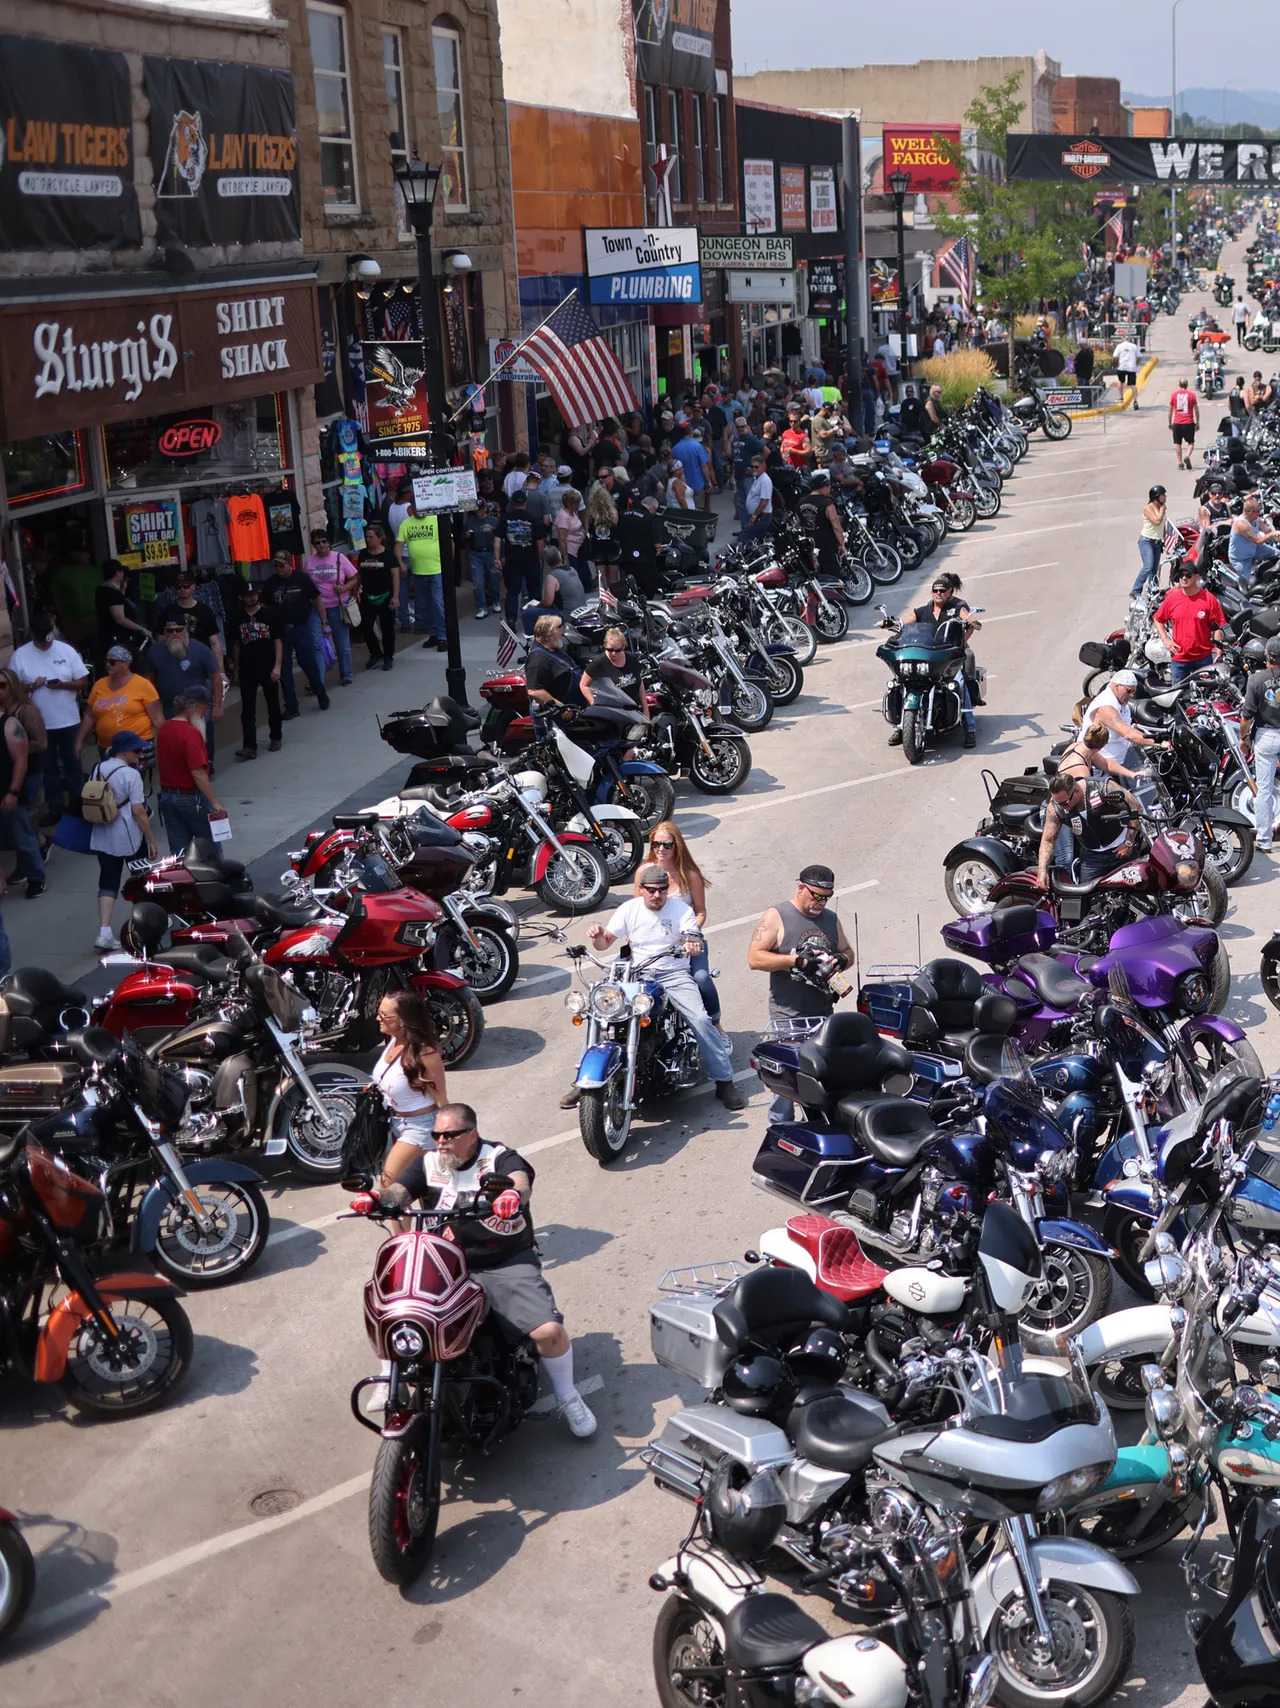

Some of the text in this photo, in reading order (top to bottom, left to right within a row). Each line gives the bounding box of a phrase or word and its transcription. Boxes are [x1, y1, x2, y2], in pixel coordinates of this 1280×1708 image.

[7, 117, 129, 167] LAW TIGERS
[890, 138, 951, 151] WELL
[248, 134, 297, 171] TIGERS
[1149, 142, 1225, 179] WE
[602, 236, 633, 254] Town
[700, 238, 792, 250] DUNGEON BAR
[636, 243, 682, 264] Country
[703, 251, 787, 261] DOWNSTAIRS
[611, 275, 693, 299] PLUMBING
[810, 284, 837, 293] DEEP
[216, 296, 285, 335] SHIRT
[220, 339, 290, 379] SHACK
[163, 426, 217, 450] OPEN
[379, 420, 421, 438] SINCE 1975
[375, 446, 427, 458] 1-800-4BIKERS
[436, 466, 465, 474] CONTAINER
[130, 511, 174, 532] SHIRT
[131, 530, 175, 544] OF THE DAY
[145, 543, 169, 561] $9.95
